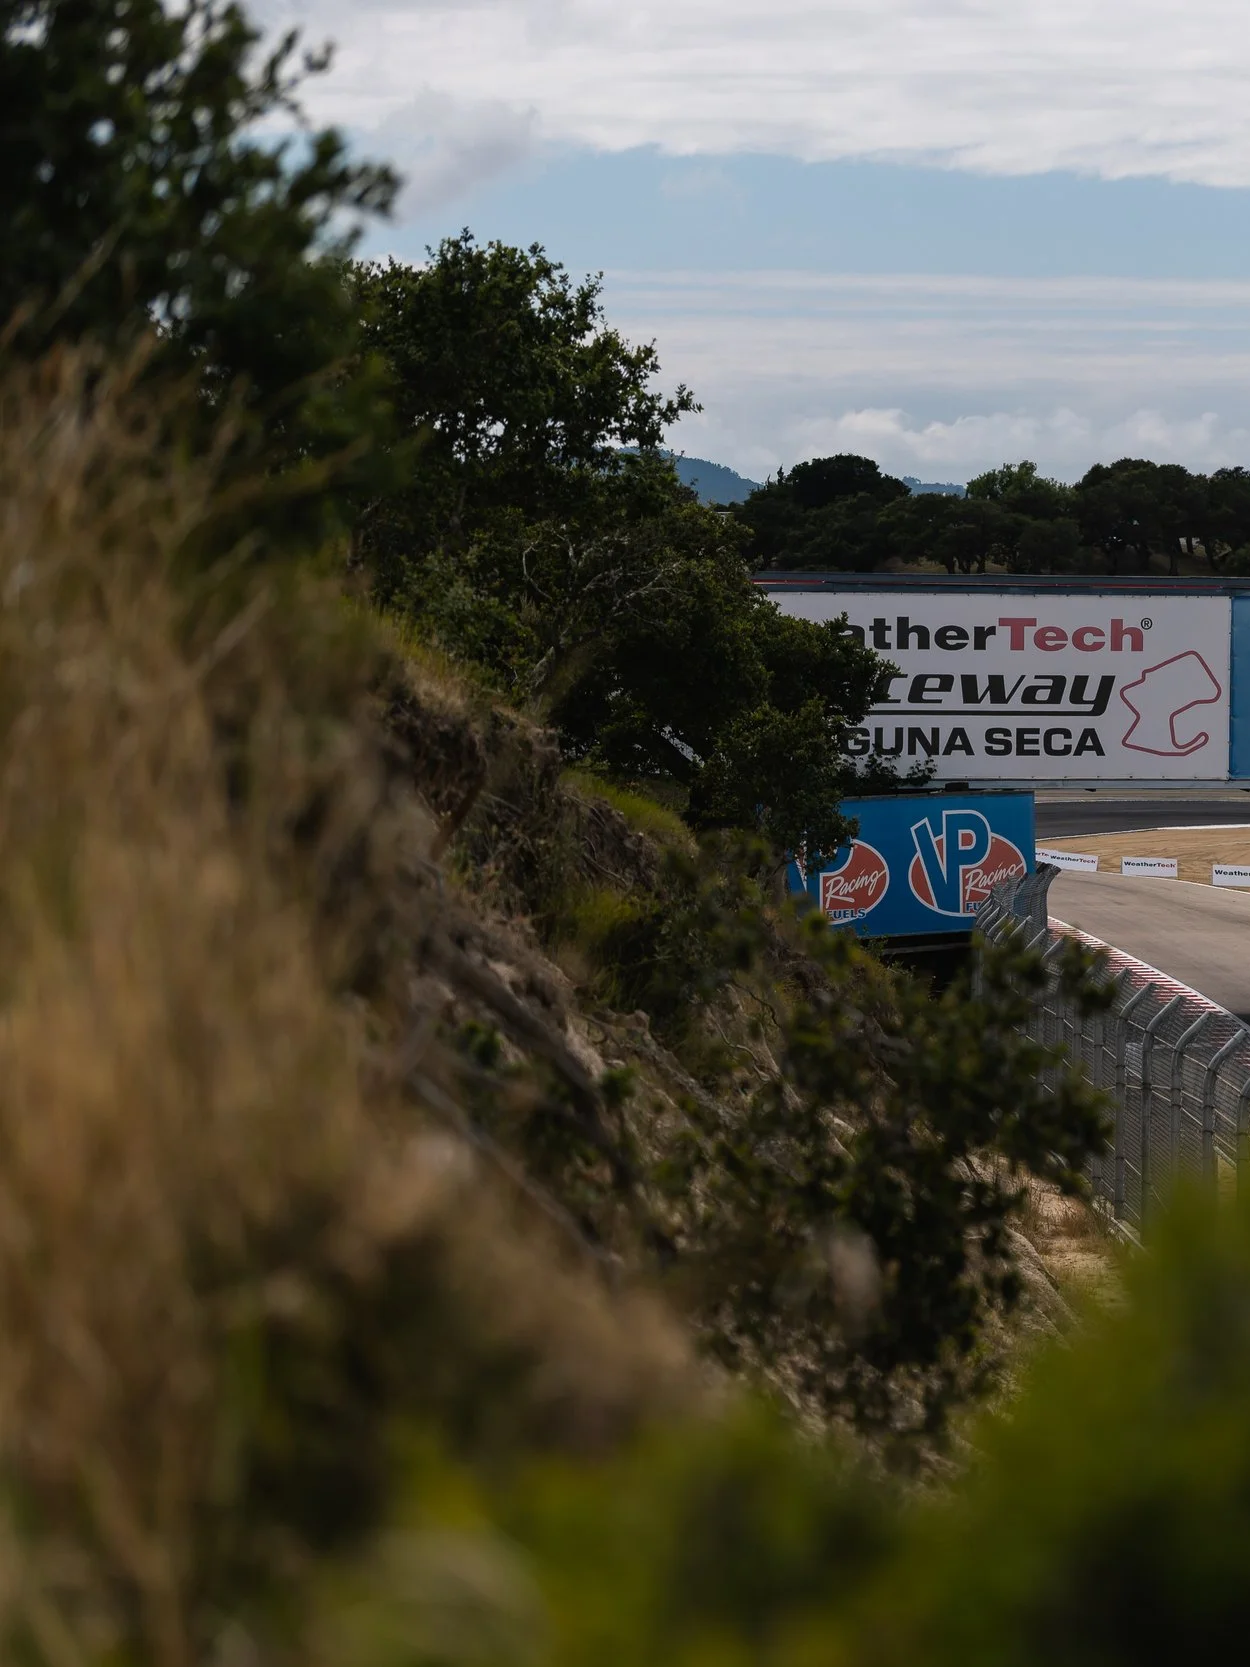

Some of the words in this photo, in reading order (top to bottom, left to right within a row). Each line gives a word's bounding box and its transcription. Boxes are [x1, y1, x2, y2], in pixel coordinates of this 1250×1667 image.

[868, 673, 1116, 717] ceway
[838, 727, 975, 757] GUNA
[984, 727, 1106, 757] SECA
[910, 809, 992, 916] VP
[1050, 855, 1097, 864] WeatherTech
[825, 868, 887, 909] Racing
